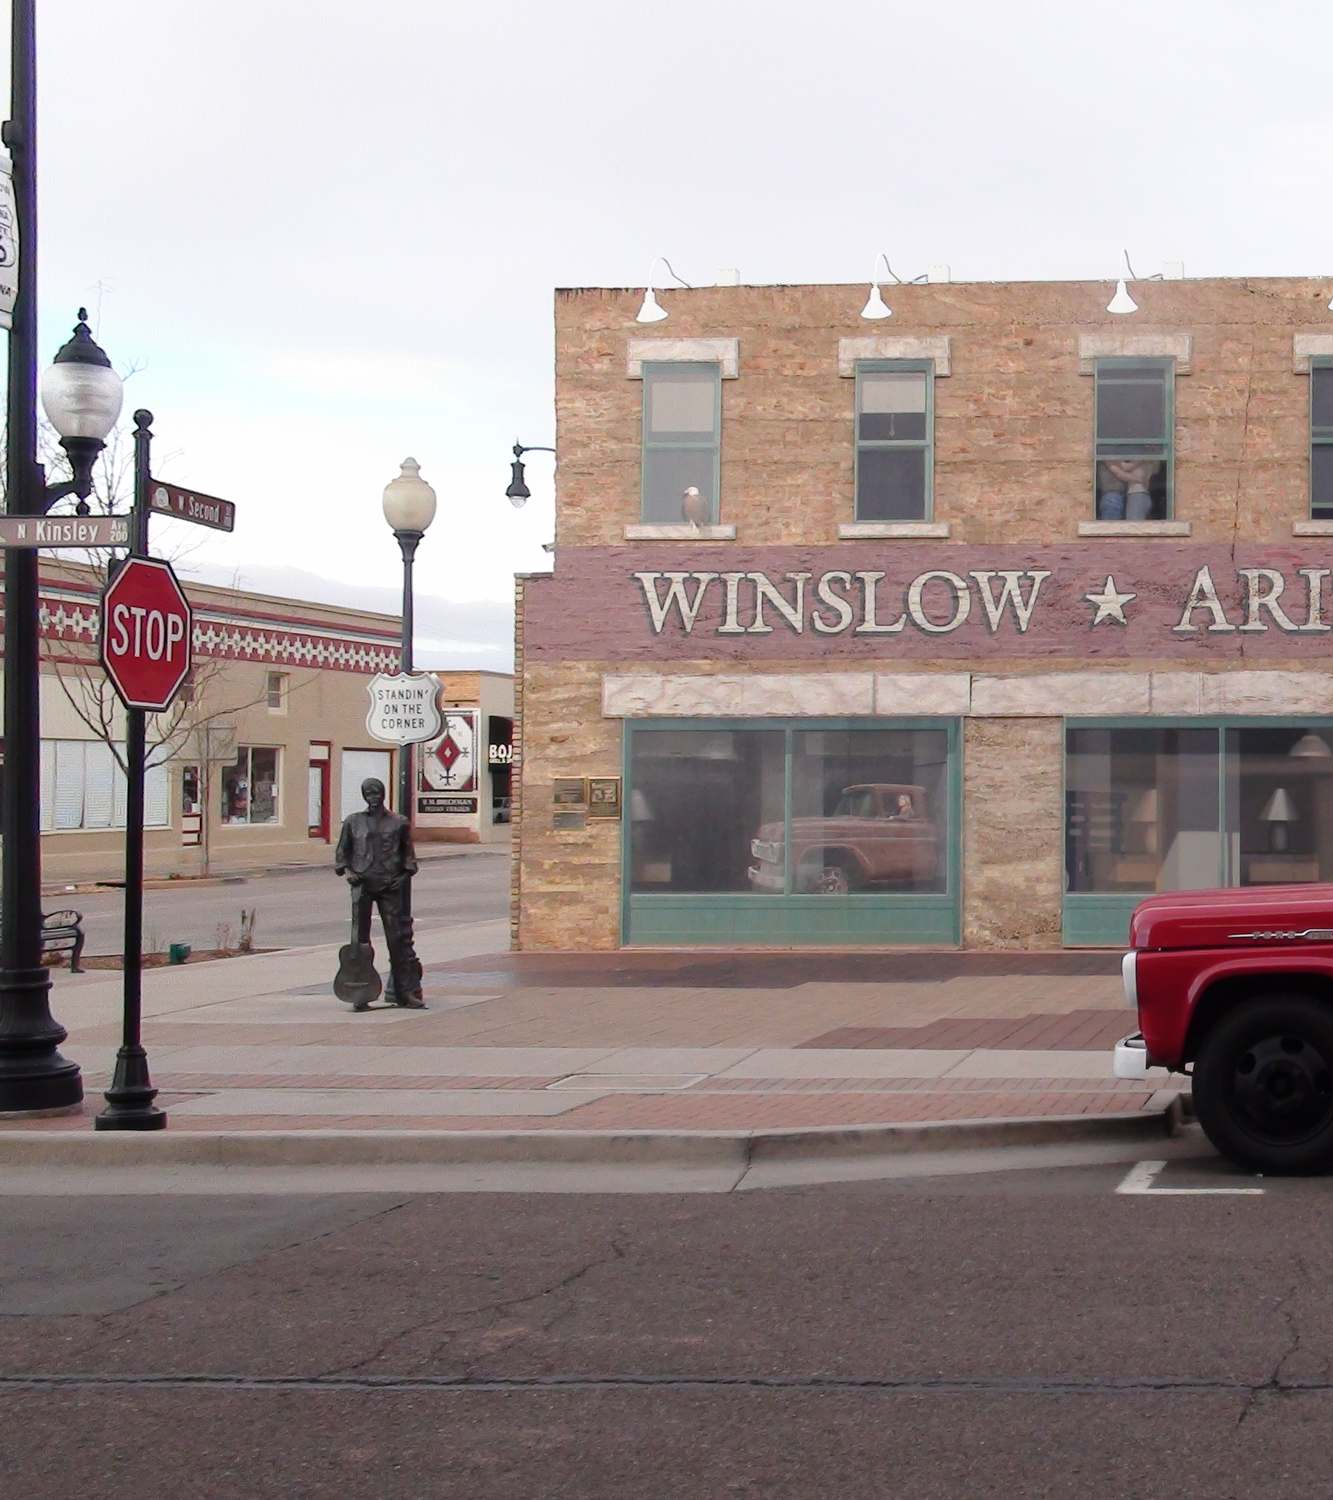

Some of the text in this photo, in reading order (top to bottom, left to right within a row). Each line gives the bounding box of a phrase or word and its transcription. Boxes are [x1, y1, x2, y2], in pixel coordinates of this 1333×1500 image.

[188, 495, 220, 523] Second
[17, 520, 128, 543] N Kinsley Ave
[110, 531, 128, 542] 200
[633, 570, 1052, 634] WINSLOW
[111, 603, 183, 662] STOP
[378, 689, 429, 700] STANDIN'
[384, 704, 423, 715] ON THE
[381, 718, 425, 729] CORNER
